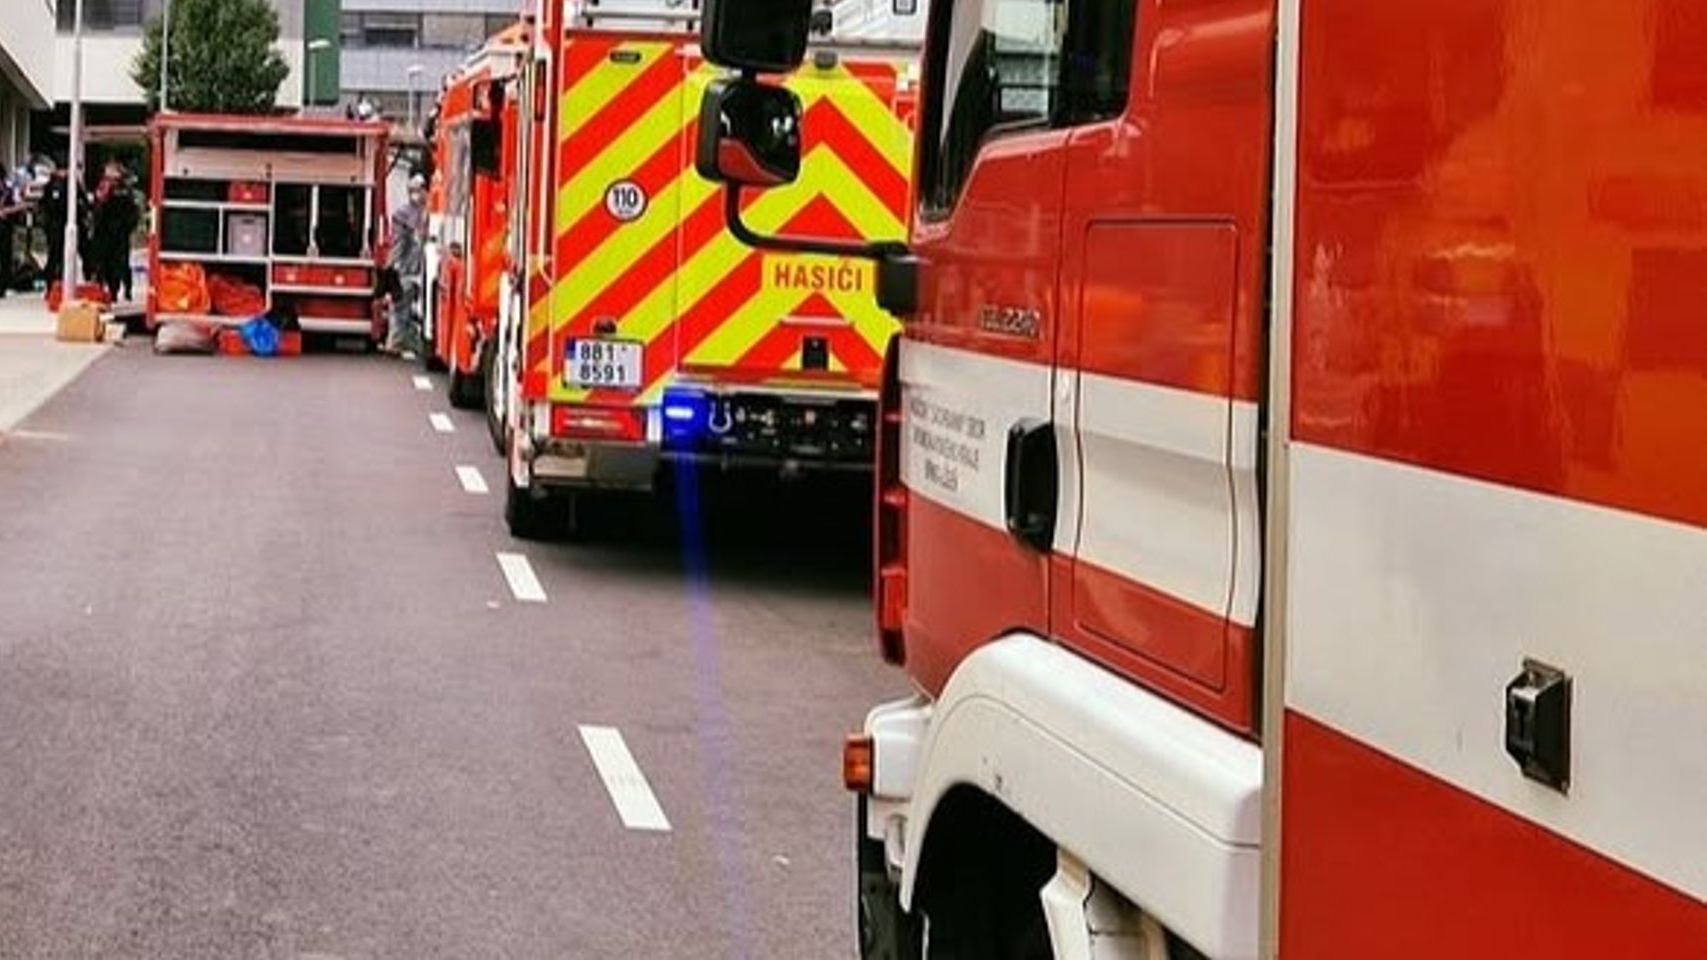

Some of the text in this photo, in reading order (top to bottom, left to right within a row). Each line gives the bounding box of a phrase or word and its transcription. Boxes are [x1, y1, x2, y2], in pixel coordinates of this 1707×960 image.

[613, 187, 639, 208] 110
[775, 259, 863, 291] HASIČI
[581, 364, 625, 382] 8591
